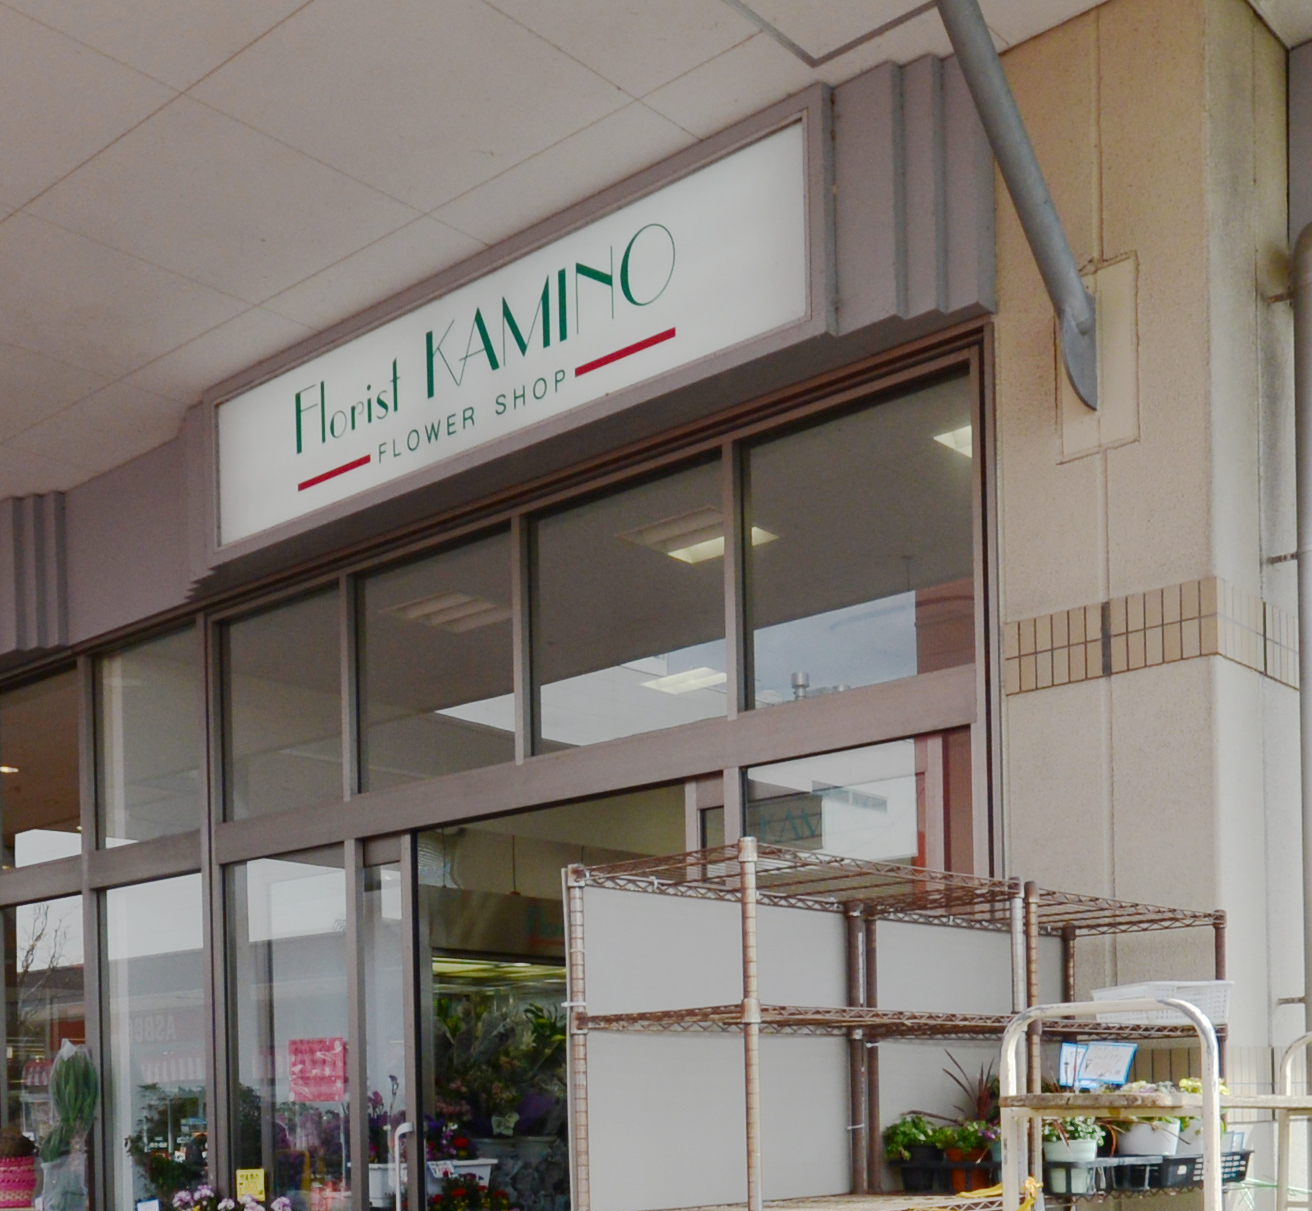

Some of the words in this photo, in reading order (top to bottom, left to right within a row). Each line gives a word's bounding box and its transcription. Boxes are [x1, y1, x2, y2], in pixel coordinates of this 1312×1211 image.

[294, 357, 398, 454] Florist
[425, 222, 676, 399] KAMINO
[378, 406, 476, 465] FLOWER
[494, 369, 567, 415] SHOP
